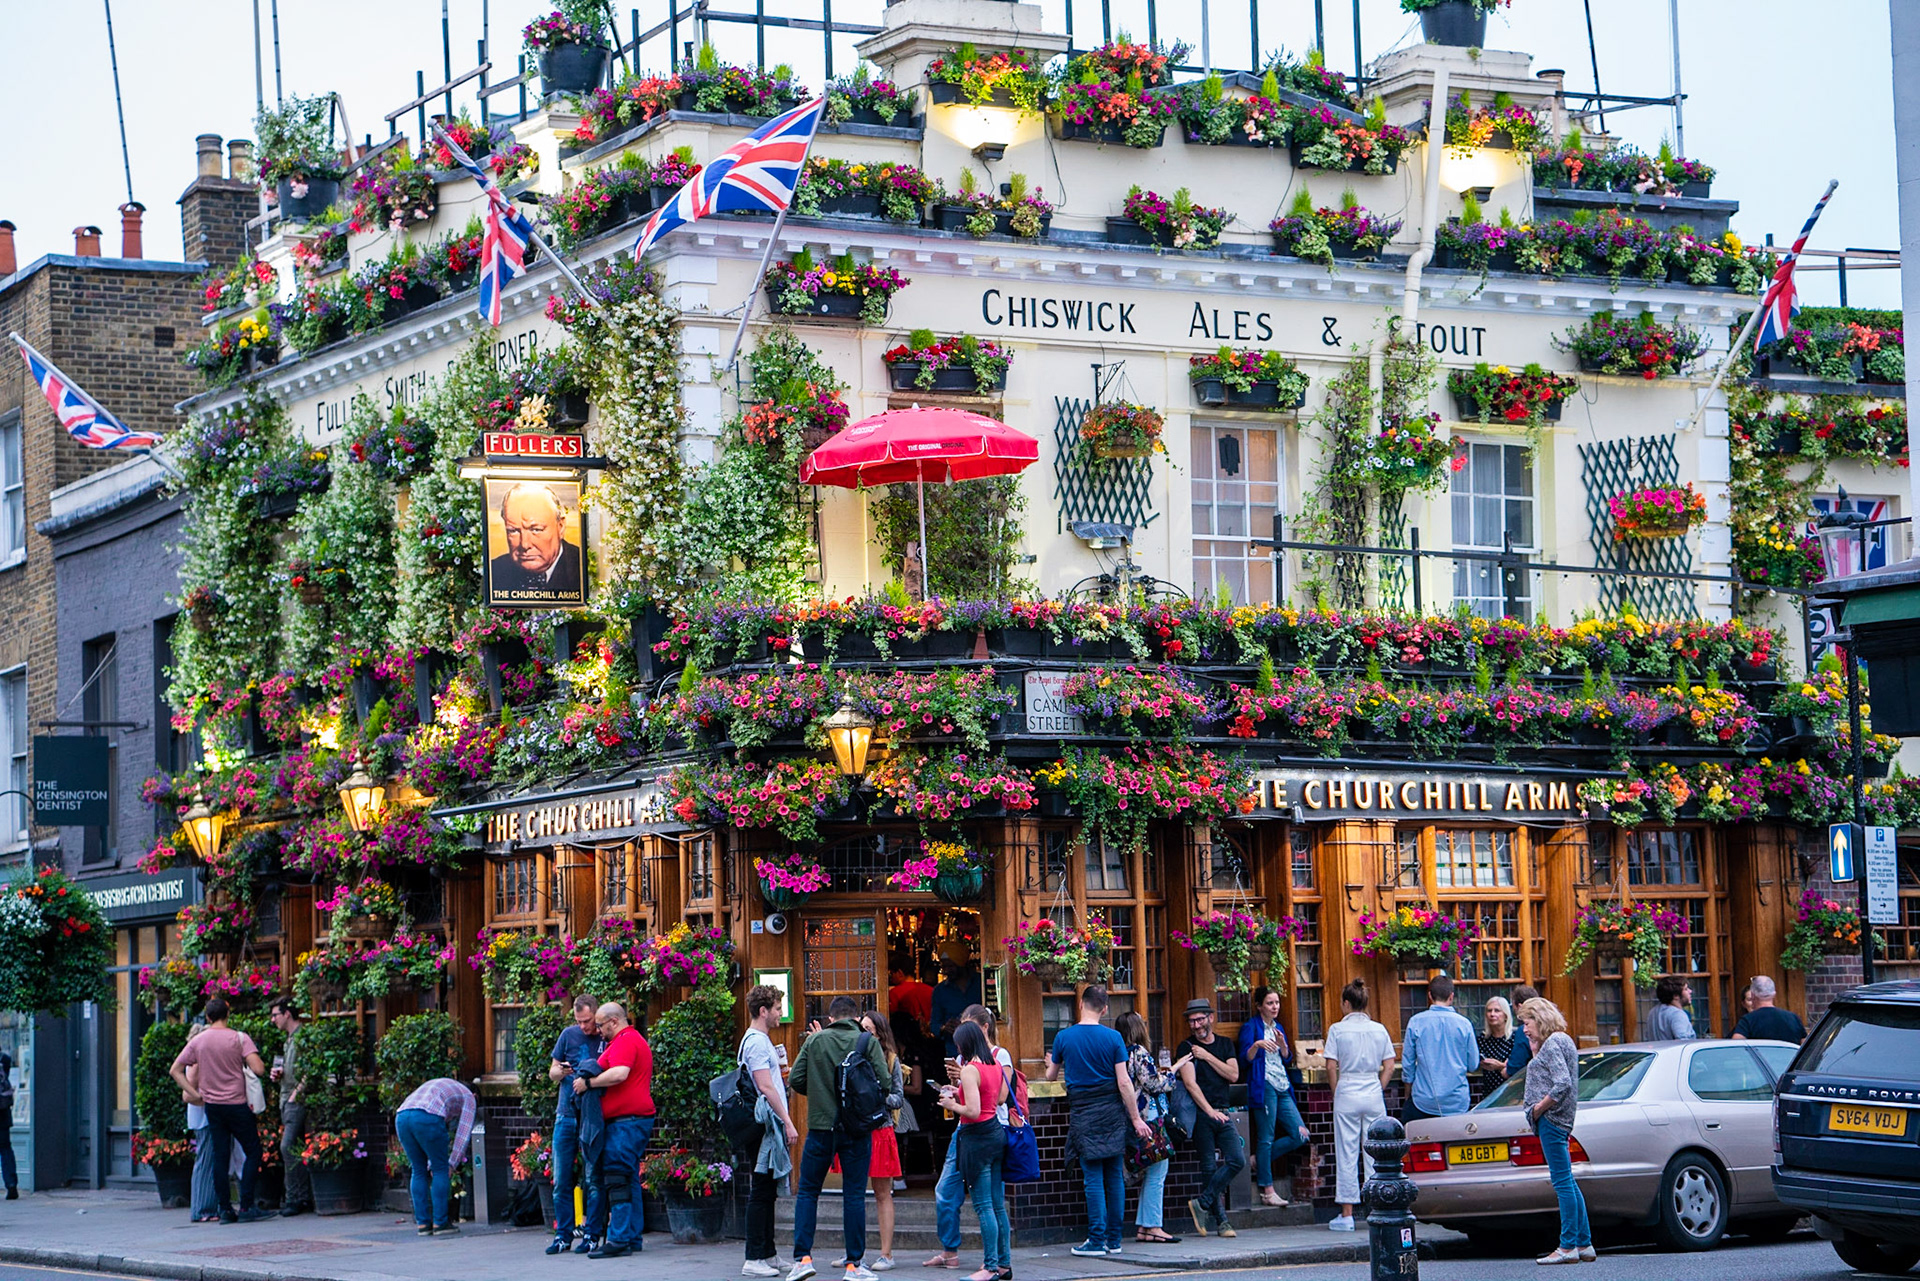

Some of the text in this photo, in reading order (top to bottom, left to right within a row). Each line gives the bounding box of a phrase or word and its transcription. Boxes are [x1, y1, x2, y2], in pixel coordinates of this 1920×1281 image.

[981, 289, 1137, 335] CHISWICK
[1188, 301, 1273, 342] ALES
[1321, 316, 1342, 347] &
[385, 370, 426, 410] SMITH
[488, 329, 538, 371] URNER
[490, 435, 577, 456] FULLER'S
[493, 590, 580, 600] THE CHURCHILL ARMS
[36, 781, 57, 790] THE
[36, 790, 107, 800] KENSINGTON
[1253, 779, 1288, 808] HE
[1304, 779, 1493, 812] CHURCHILL
[36, 801, 82, 810] DENTIST
[526, 796, 634, 839] CHURCHILL
[95, 885, 147, 908] KENSINGTON
[147, 880, 183, 902] DENTIST
[1808, 1085, 1858, 1096] RANGE
[1837, 1109, 1900, 1129] SV64 VDJ
[1460, 1146, 1496, 1161] A8 GBT
